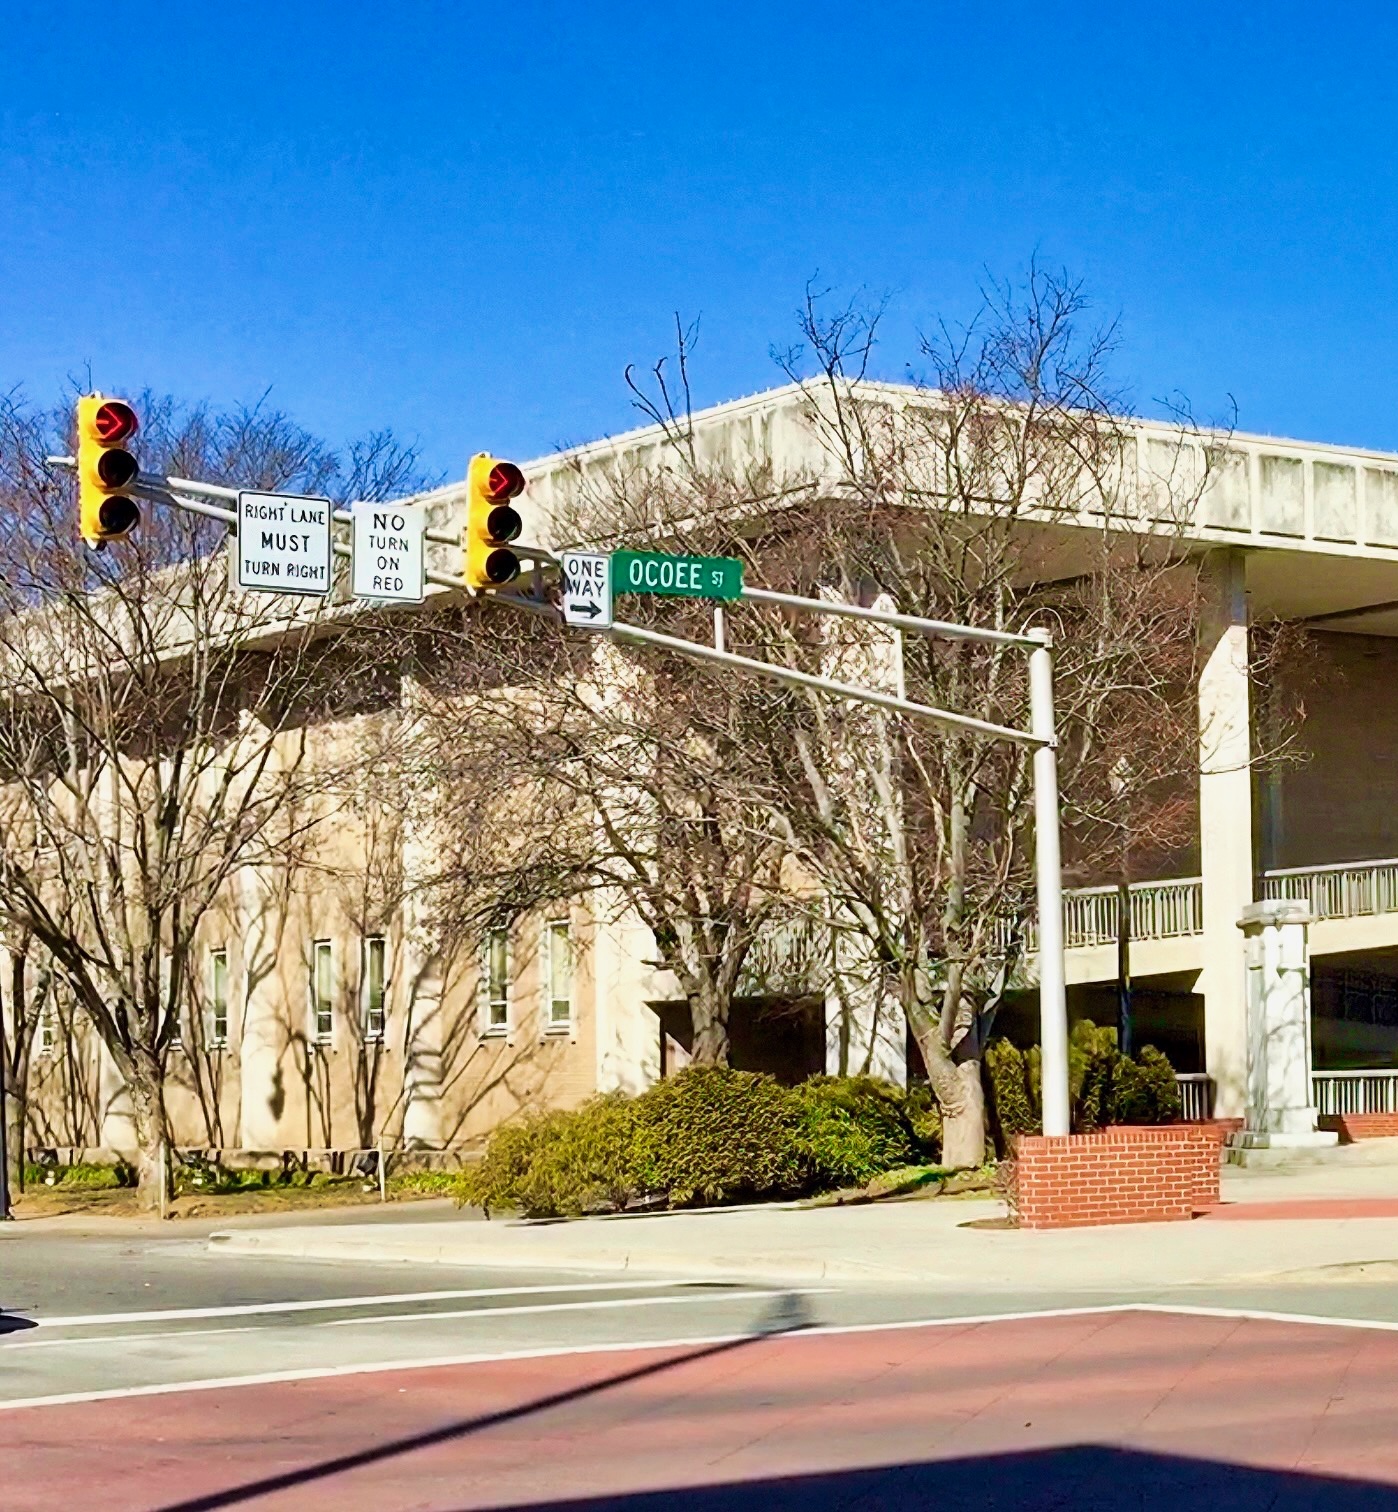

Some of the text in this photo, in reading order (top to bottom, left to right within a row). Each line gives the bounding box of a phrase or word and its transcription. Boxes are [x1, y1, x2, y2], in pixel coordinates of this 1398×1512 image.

[245, 503, 326, 526] RIGHT LANE
[373, 513, 405, 532] NO
[261, 531, 311, 553] MUST
[368, 534, 409, 552] TURN
[244, 559, 326, 580] TURN RIGHT
[377, 555, 400, 571] ON
[568, 559, 605, 578] ONE
[373, 575, 404, 592] RED
[629, 558, 724, 590] OCOEE ST
[566, 579, 606, 598] WAY
